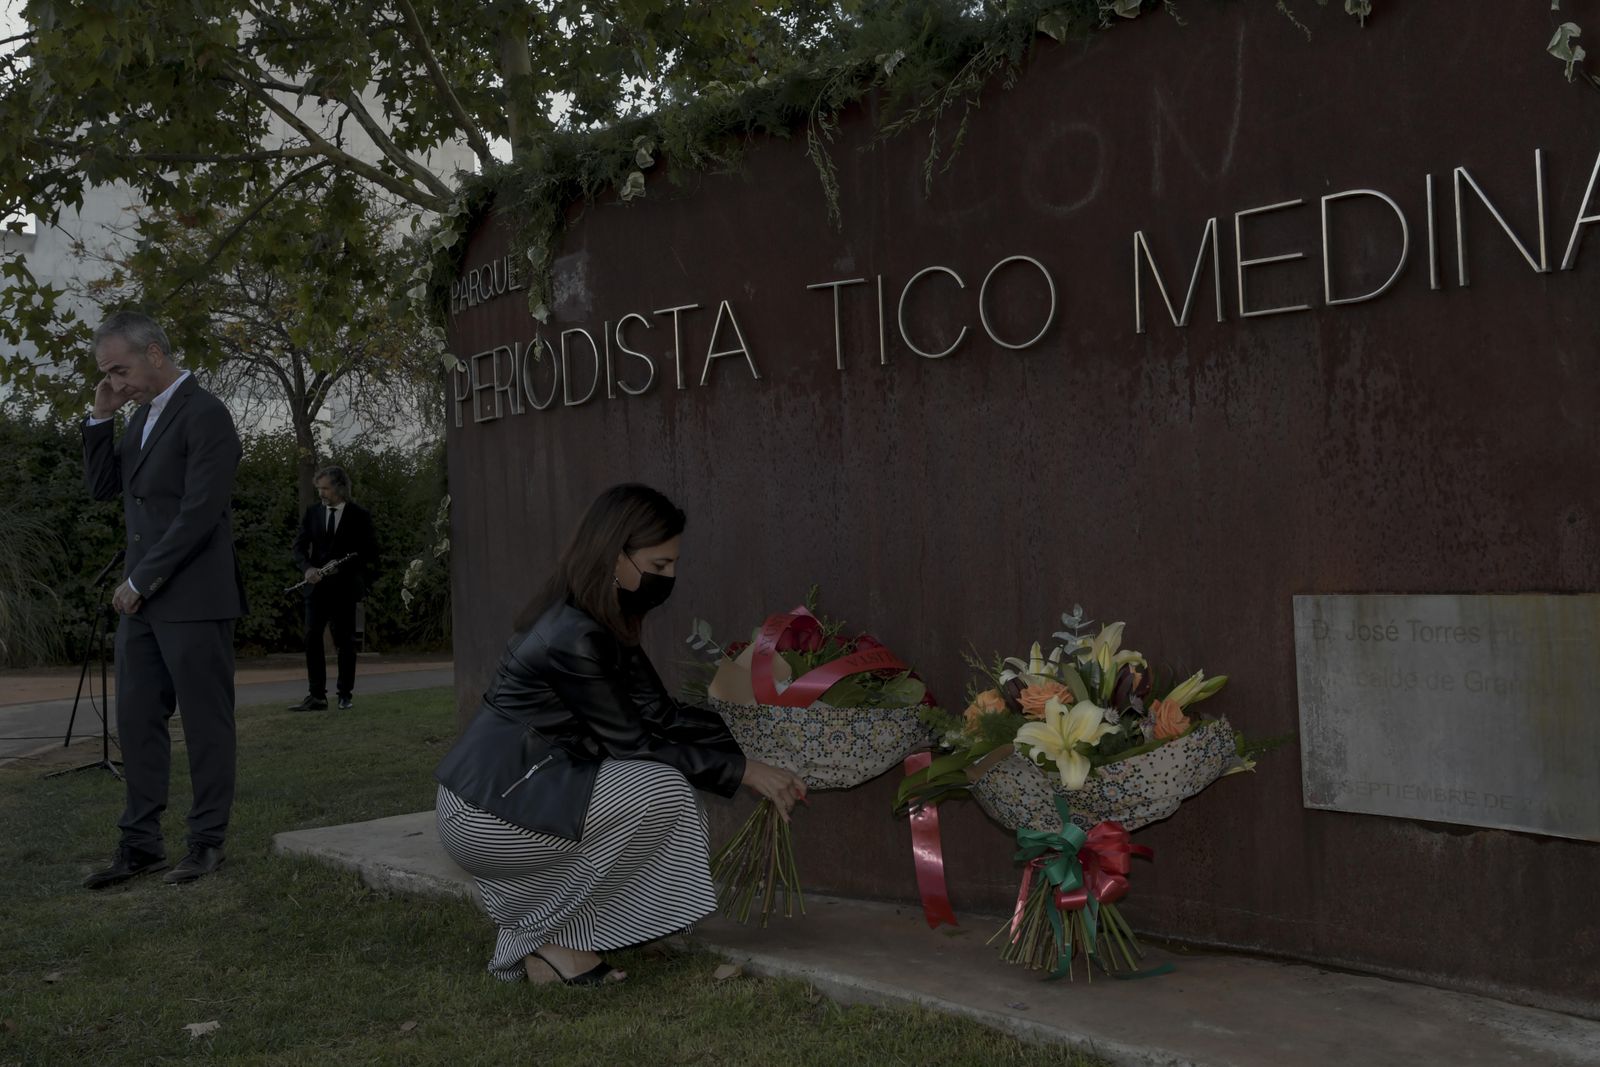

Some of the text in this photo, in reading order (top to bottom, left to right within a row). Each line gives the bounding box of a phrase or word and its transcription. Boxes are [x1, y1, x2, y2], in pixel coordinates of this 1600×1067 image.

[451, 254, 522, 315] PARQUE
[454, 299, 762, 428] PERIODISTA
[806, 254, 1057, 371] TICO
[1345, 619, 1399, 642] José
[1407, 619, 1481, 644] Torres
[1340, 778, 1477, 808] SEPTIEMBRE
[1484, 792, 1514, 810] DE
